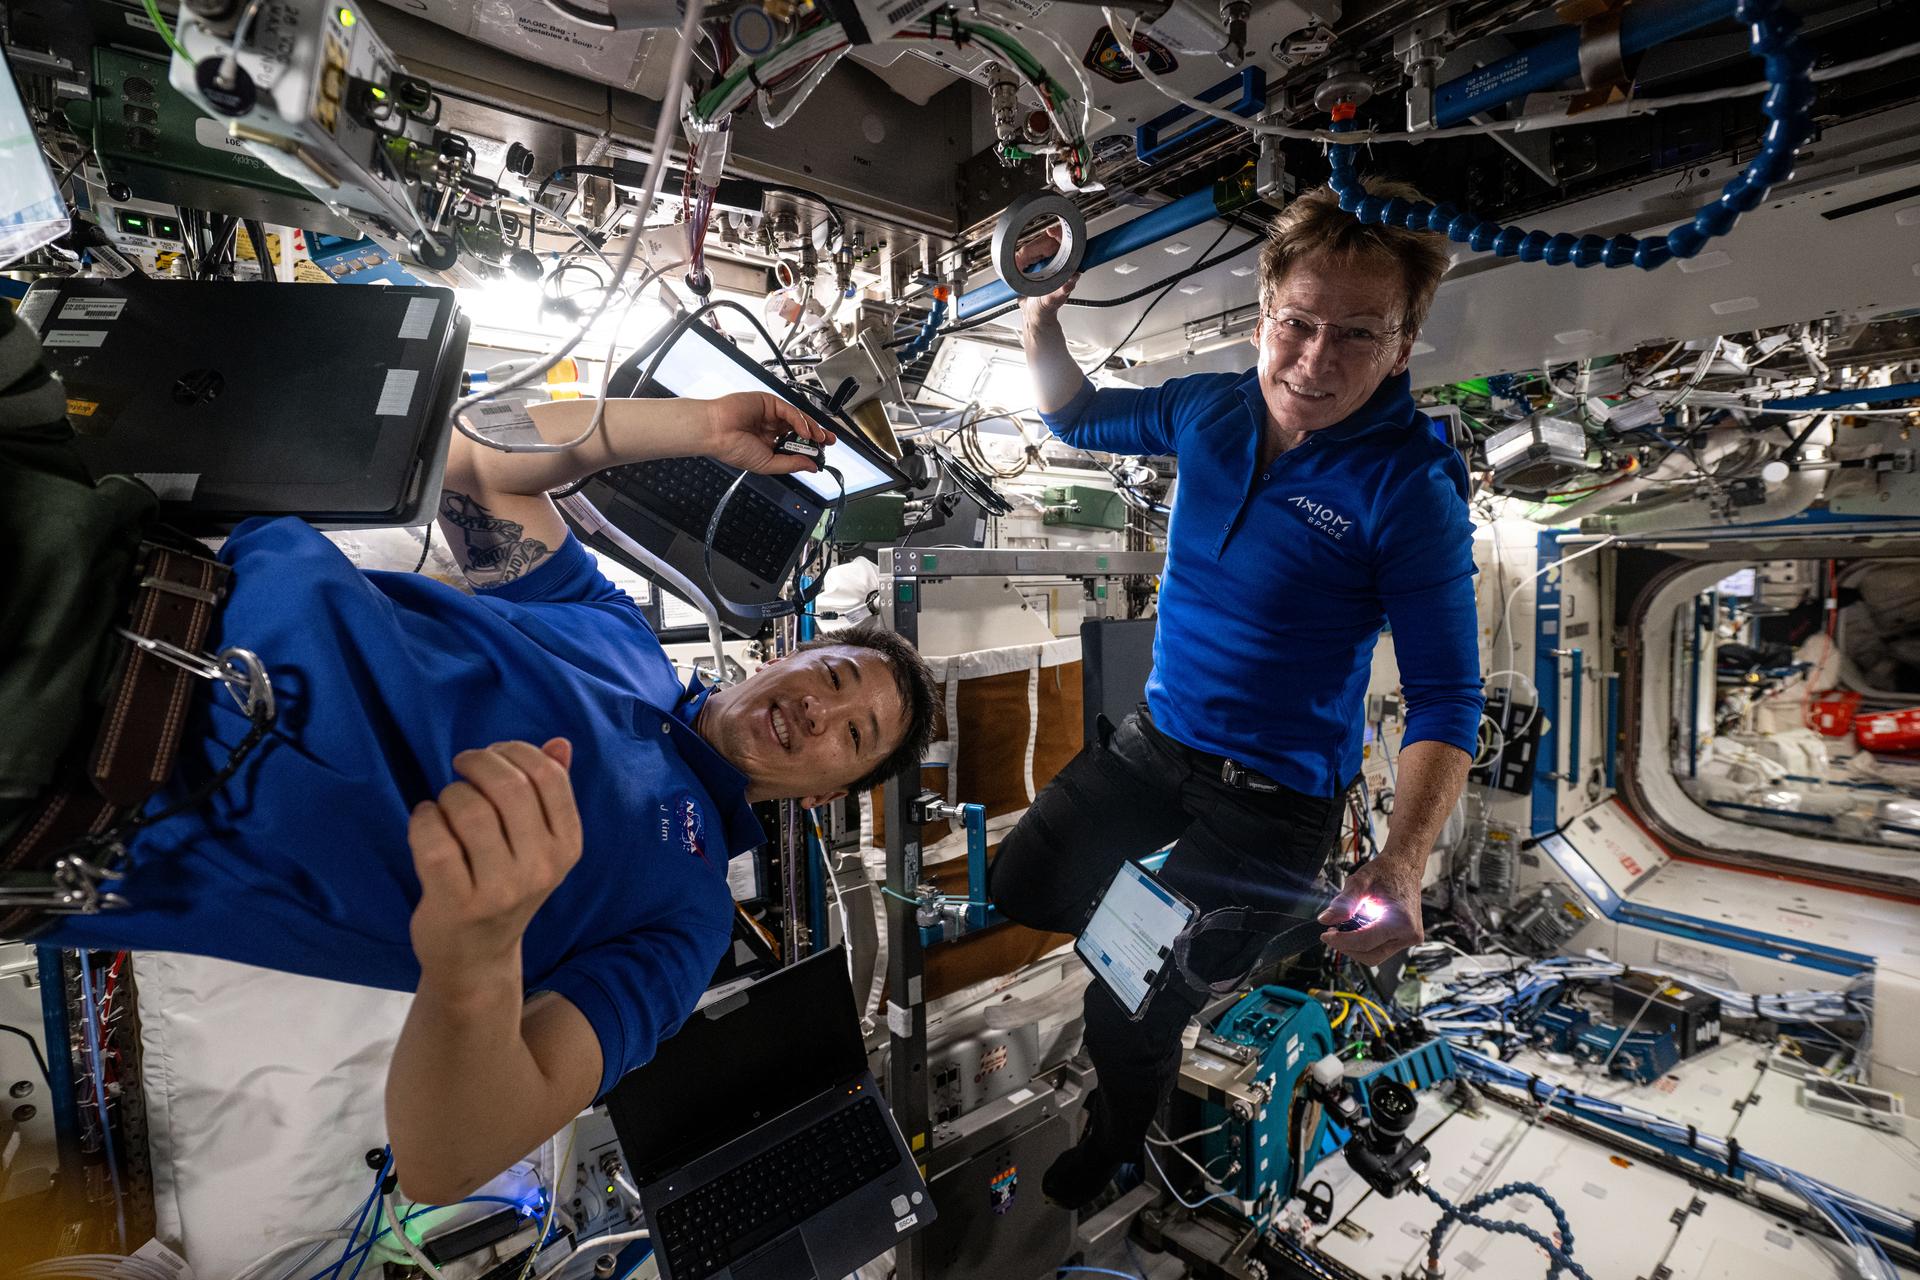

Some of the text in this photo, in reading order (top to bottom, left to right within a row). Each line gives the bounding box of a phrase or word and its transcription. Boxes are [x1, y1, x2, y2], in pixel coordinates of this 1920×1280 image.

[518, 17, 547, 29] MAGIC
[549, 25, 566, 35] Bag
[572, 38, 592, 49] Soup
[232, 154, 259, 169] Supply
[1287, 495, 1353, 532] AXIOM
[1307, 516, 1343, 540] SPACE
[659, 804, 670, 841] J Kim
[686, 800, 697, 854] NASA
